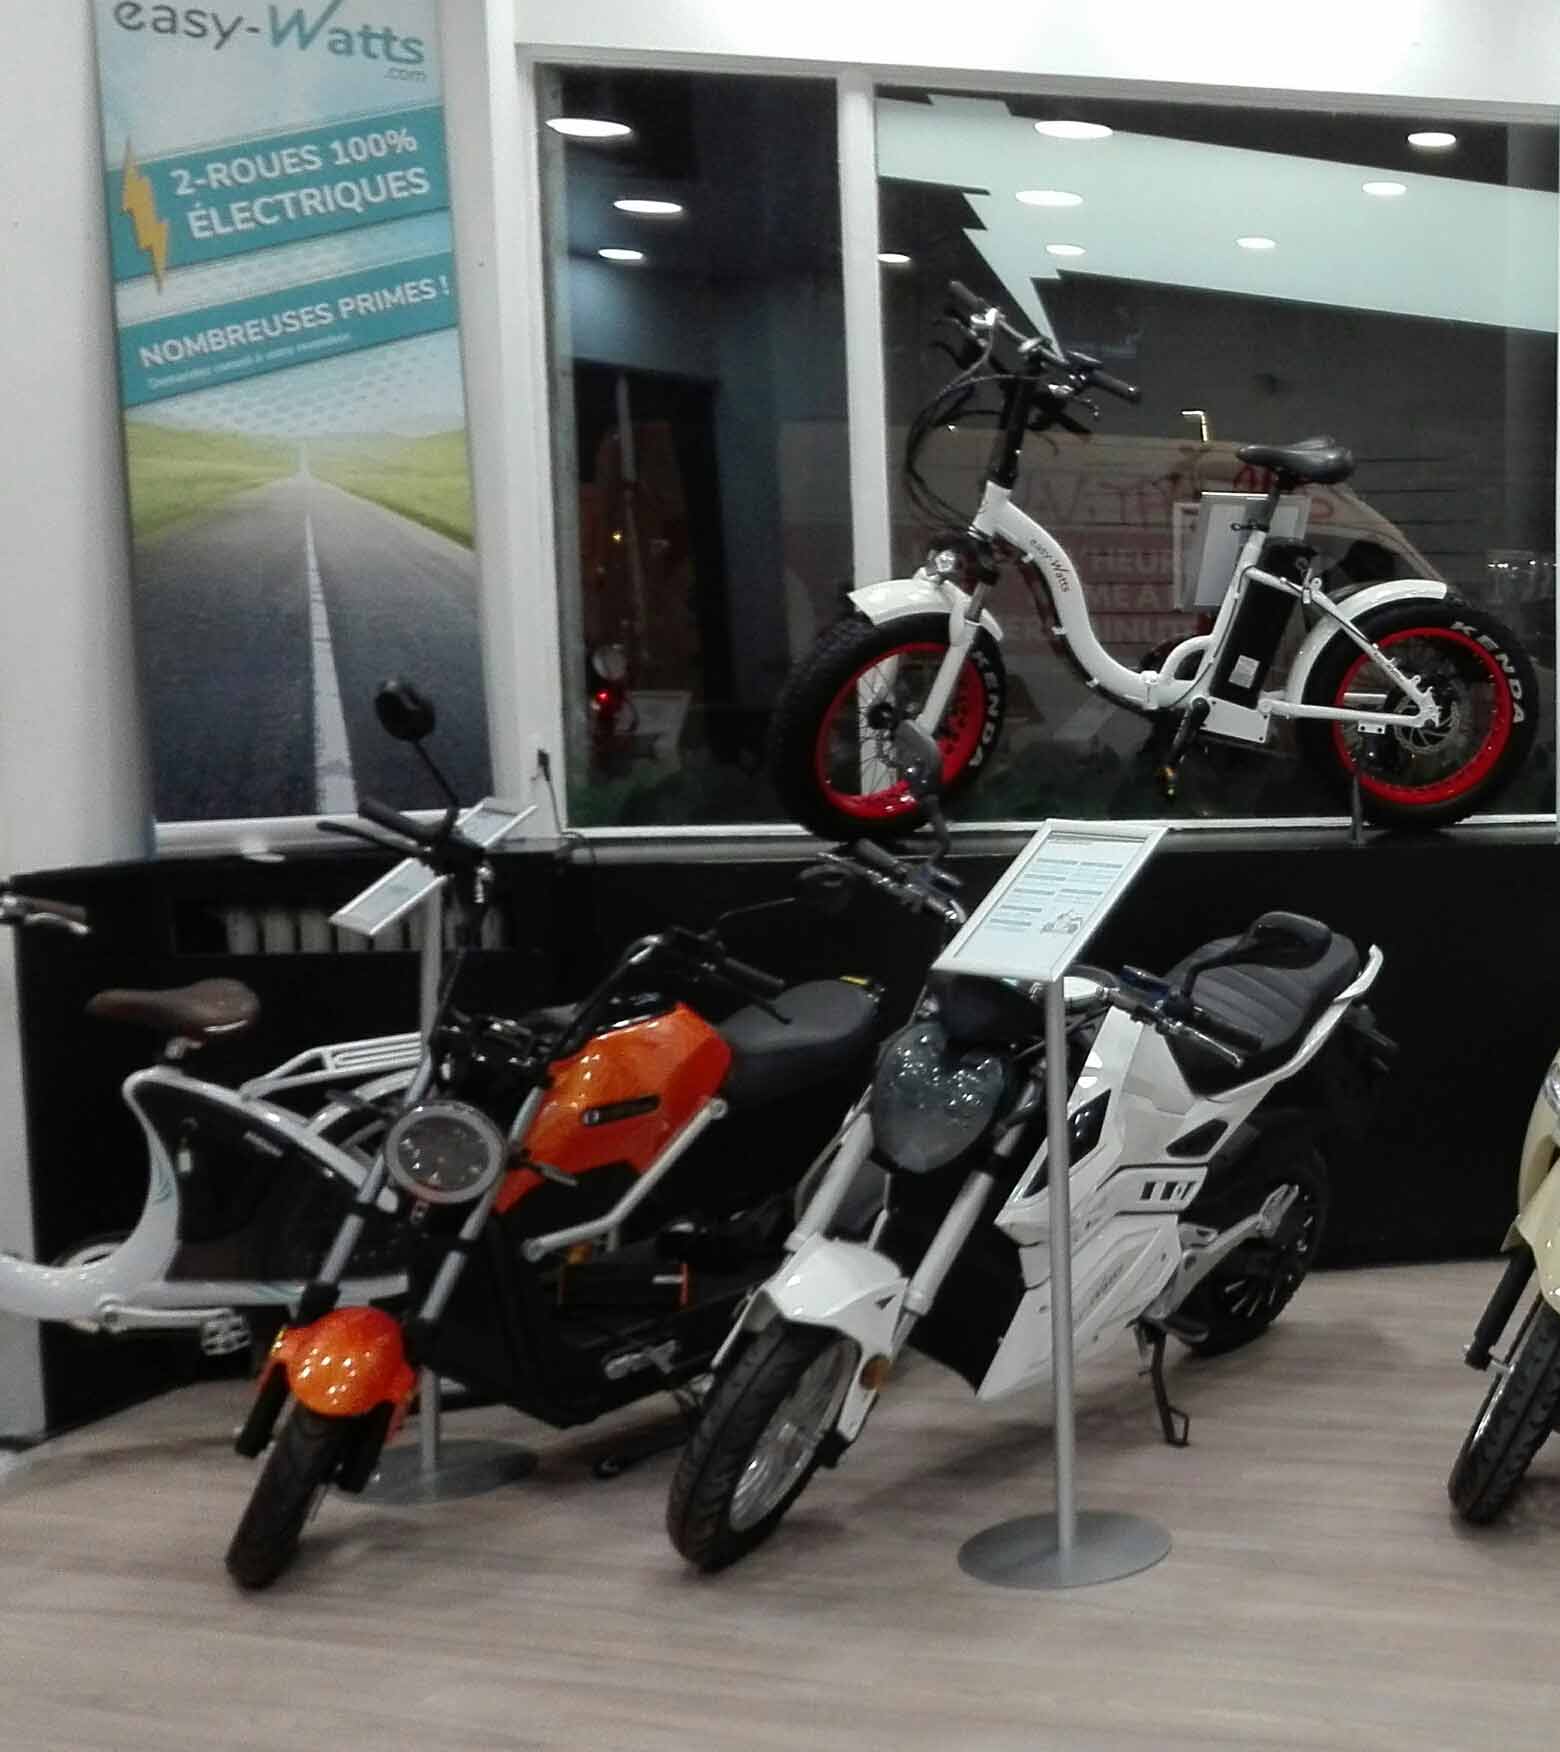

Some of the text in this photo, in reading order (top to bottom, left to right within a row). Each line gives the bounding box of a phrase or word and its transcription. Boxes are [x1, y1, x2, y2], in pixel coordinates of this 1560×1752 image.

[113, 0, 426, 65] easy-Watts
[171, 128, 417, 197] 2-ROUES 100%
[186, 167, 431, 241] ÉLECTRIQUES
[138, 303, 334, 368] NOMBREUSES
[338, 281, 437, 320] PRIMES
[1449, 621, 1525, 724] KENDA
